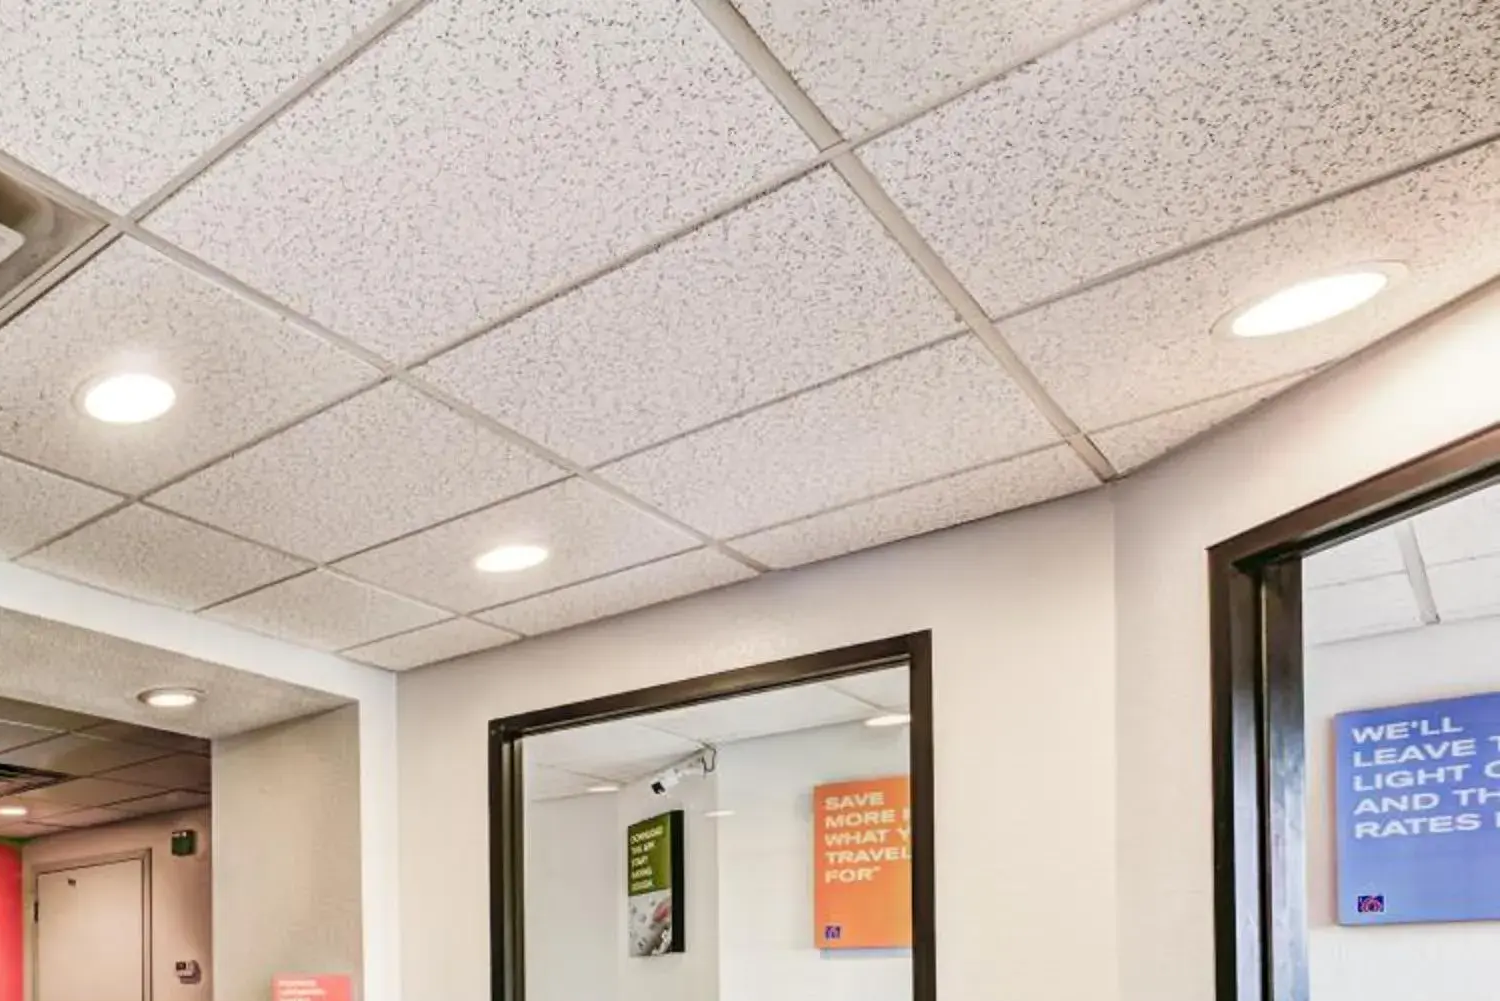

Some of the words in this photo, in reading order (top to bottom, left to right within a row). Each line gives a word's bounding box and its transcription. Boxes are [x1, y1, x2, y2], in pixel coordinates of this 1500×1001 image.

[1352, 716, 1463, 743] WE'LL
[1353, 738, 1476, 767] LEAVE
[1353, 763, 1470, 792] LIGHT
[824, 792, 885, 811] SAVE
[1353, 792, 1441, 816] AND
[1452, 787, 1500, 807] TH
[825, 809, 895, 829] MORE
[1354, 813, 1482, 839] RATES
[824, 829, 891, 847] WHAT
